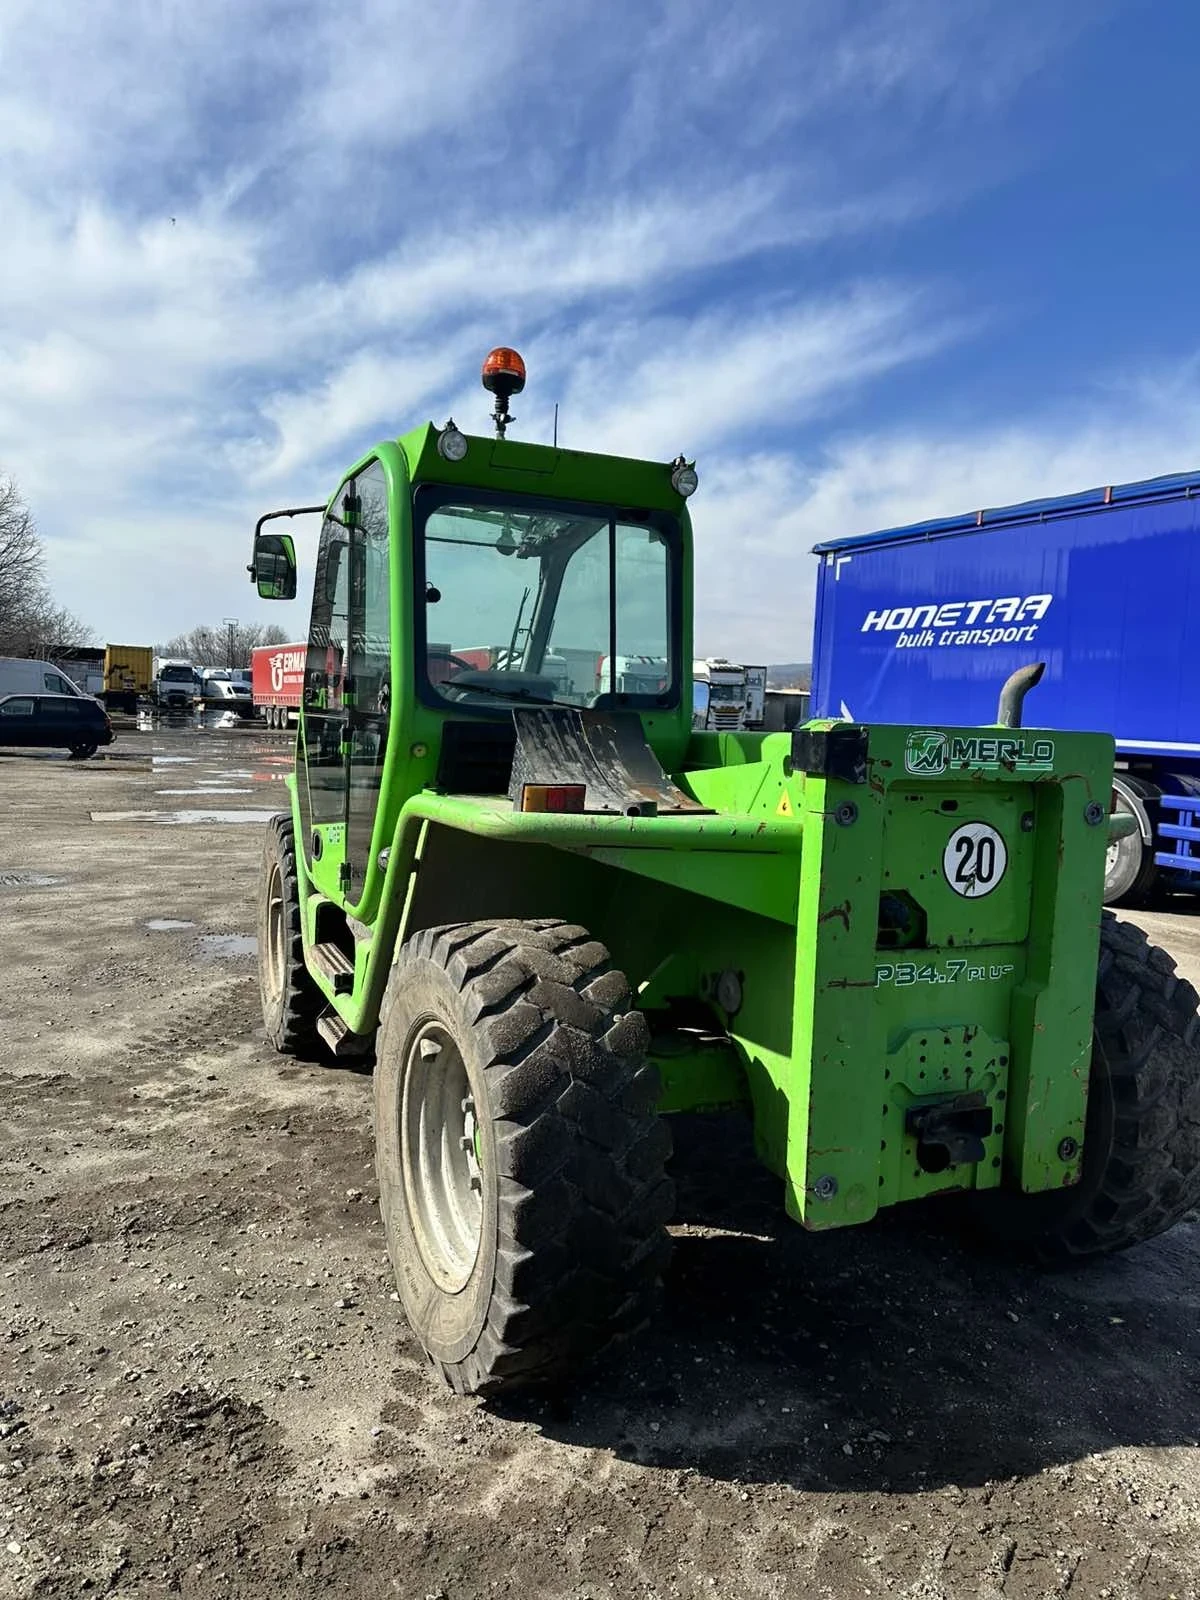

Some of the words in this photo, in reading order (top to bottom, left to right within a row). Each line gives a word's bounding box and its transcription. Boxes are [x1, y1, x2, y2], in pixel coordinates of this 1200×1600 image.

[896, 629, 936, 648] bulk
[939, 623, 1039, 646] transport
[268, 651, 307, 691] GERMA
[952, 737, 1055, 762] MERLO
[955, 836, 996, 883] 20
[874, 959, 968, 988] P34.7
